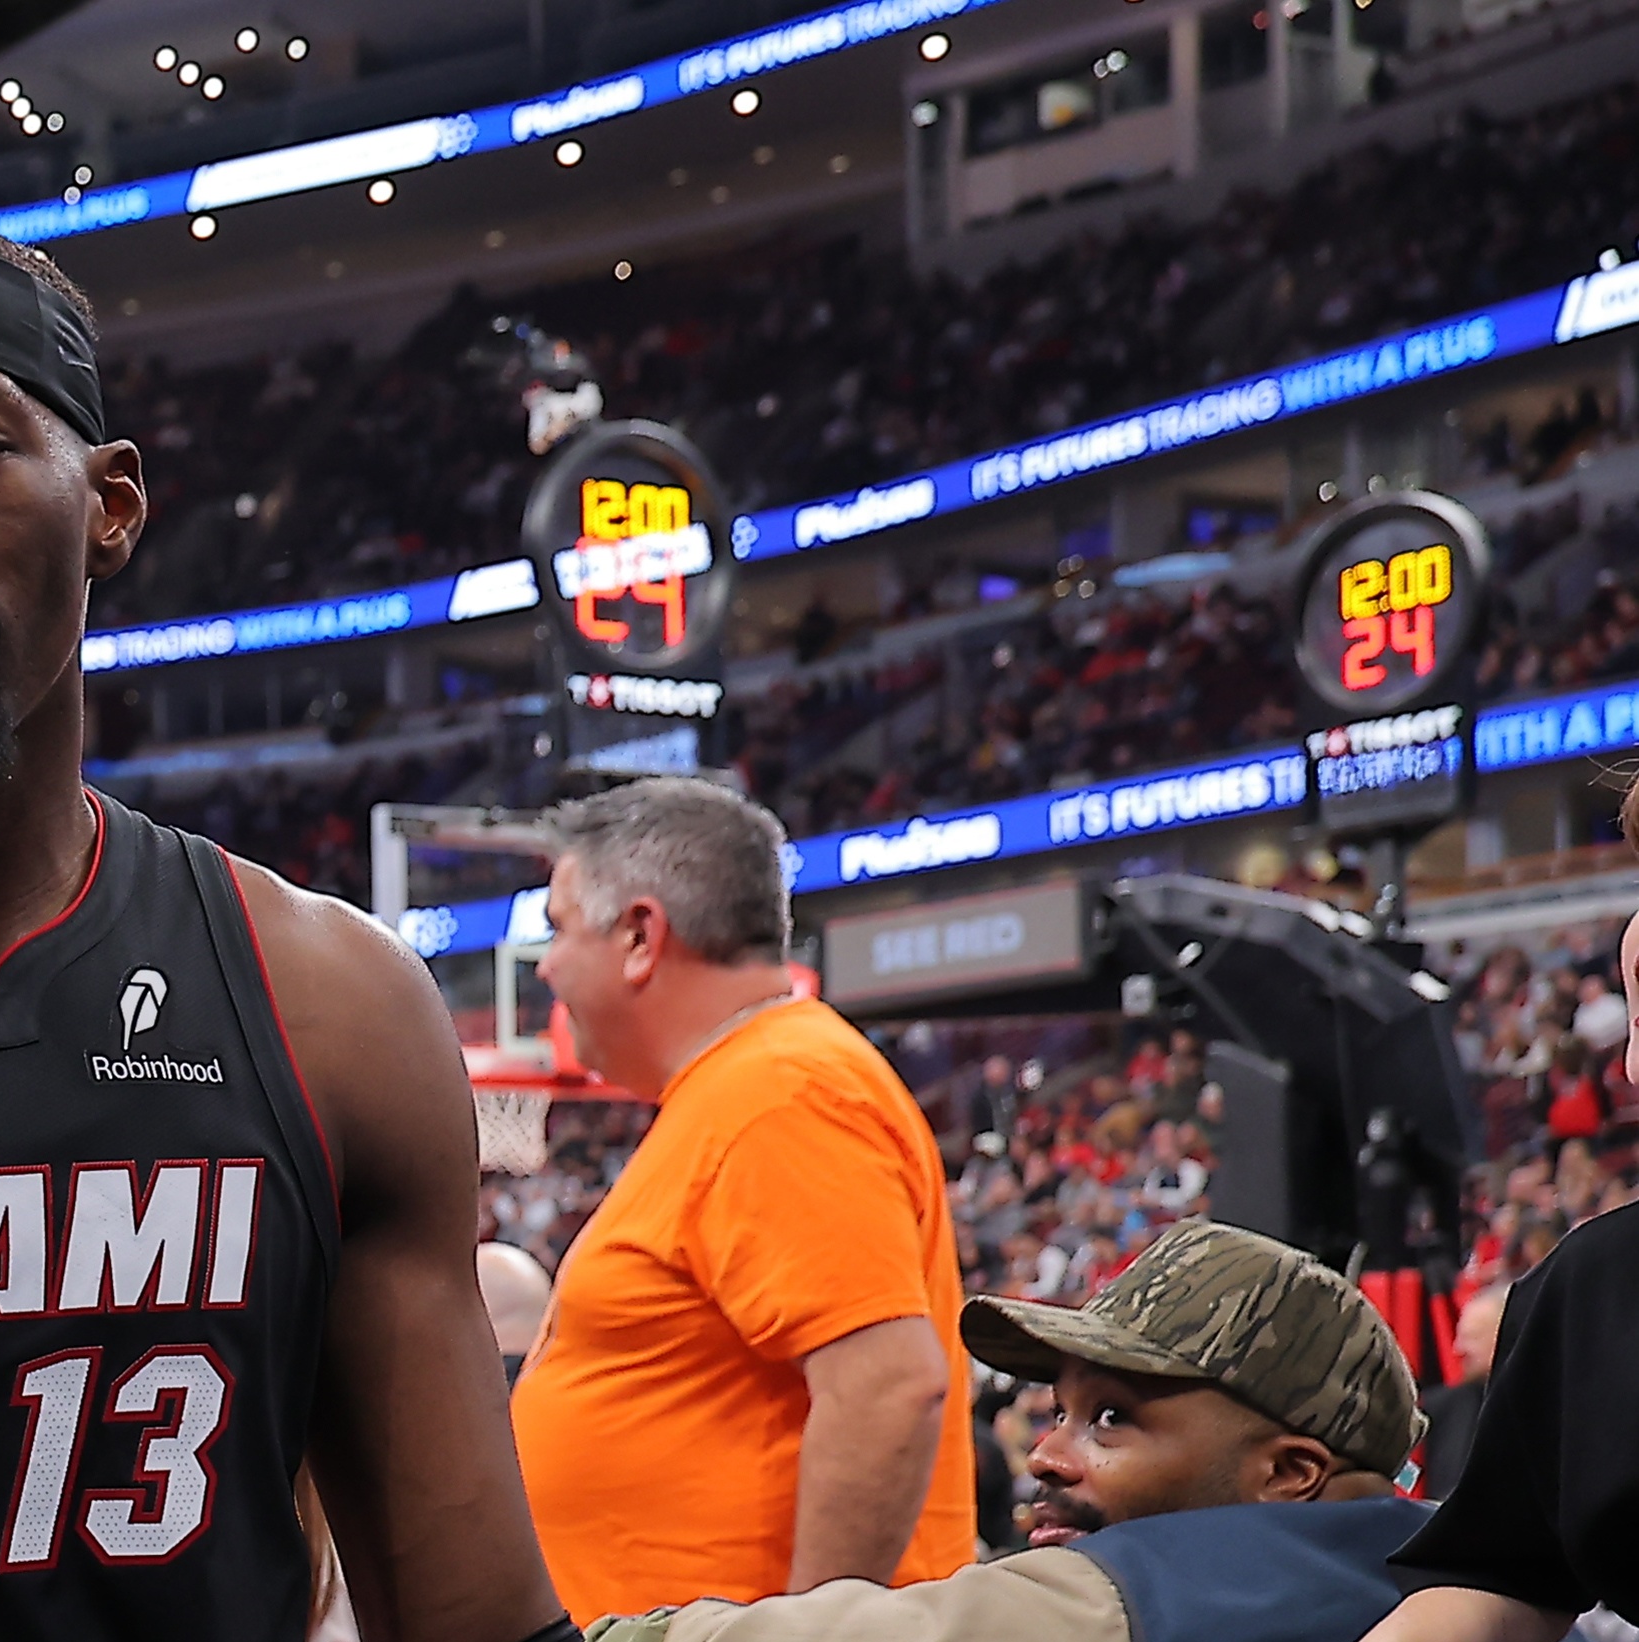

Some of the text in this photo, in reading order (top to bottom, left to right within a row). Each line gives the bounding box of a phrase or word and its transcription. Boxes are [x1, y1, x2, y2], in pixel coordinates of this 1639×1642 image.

[1148, 377, 1282, 450] TRADING
[1282, 349, 1374, 411] WITH
[1373, 341, 1404, 387] A
[1404, 314, 1496, 379] PLUS
[1340, 544, 1453, 621] 12:00
[1342, 605, 1435, 691] 24
[1475, 706, 1562, 770] ITH
[1563, 700, 1603, 752] A
[1049, 789, 1110, 845] IT'S
[1110, 761, 1270, 834] FUTURES
[872, 912, 1022, 976] SEE RED
[92, 1055, 224, 1084] Robinhood
